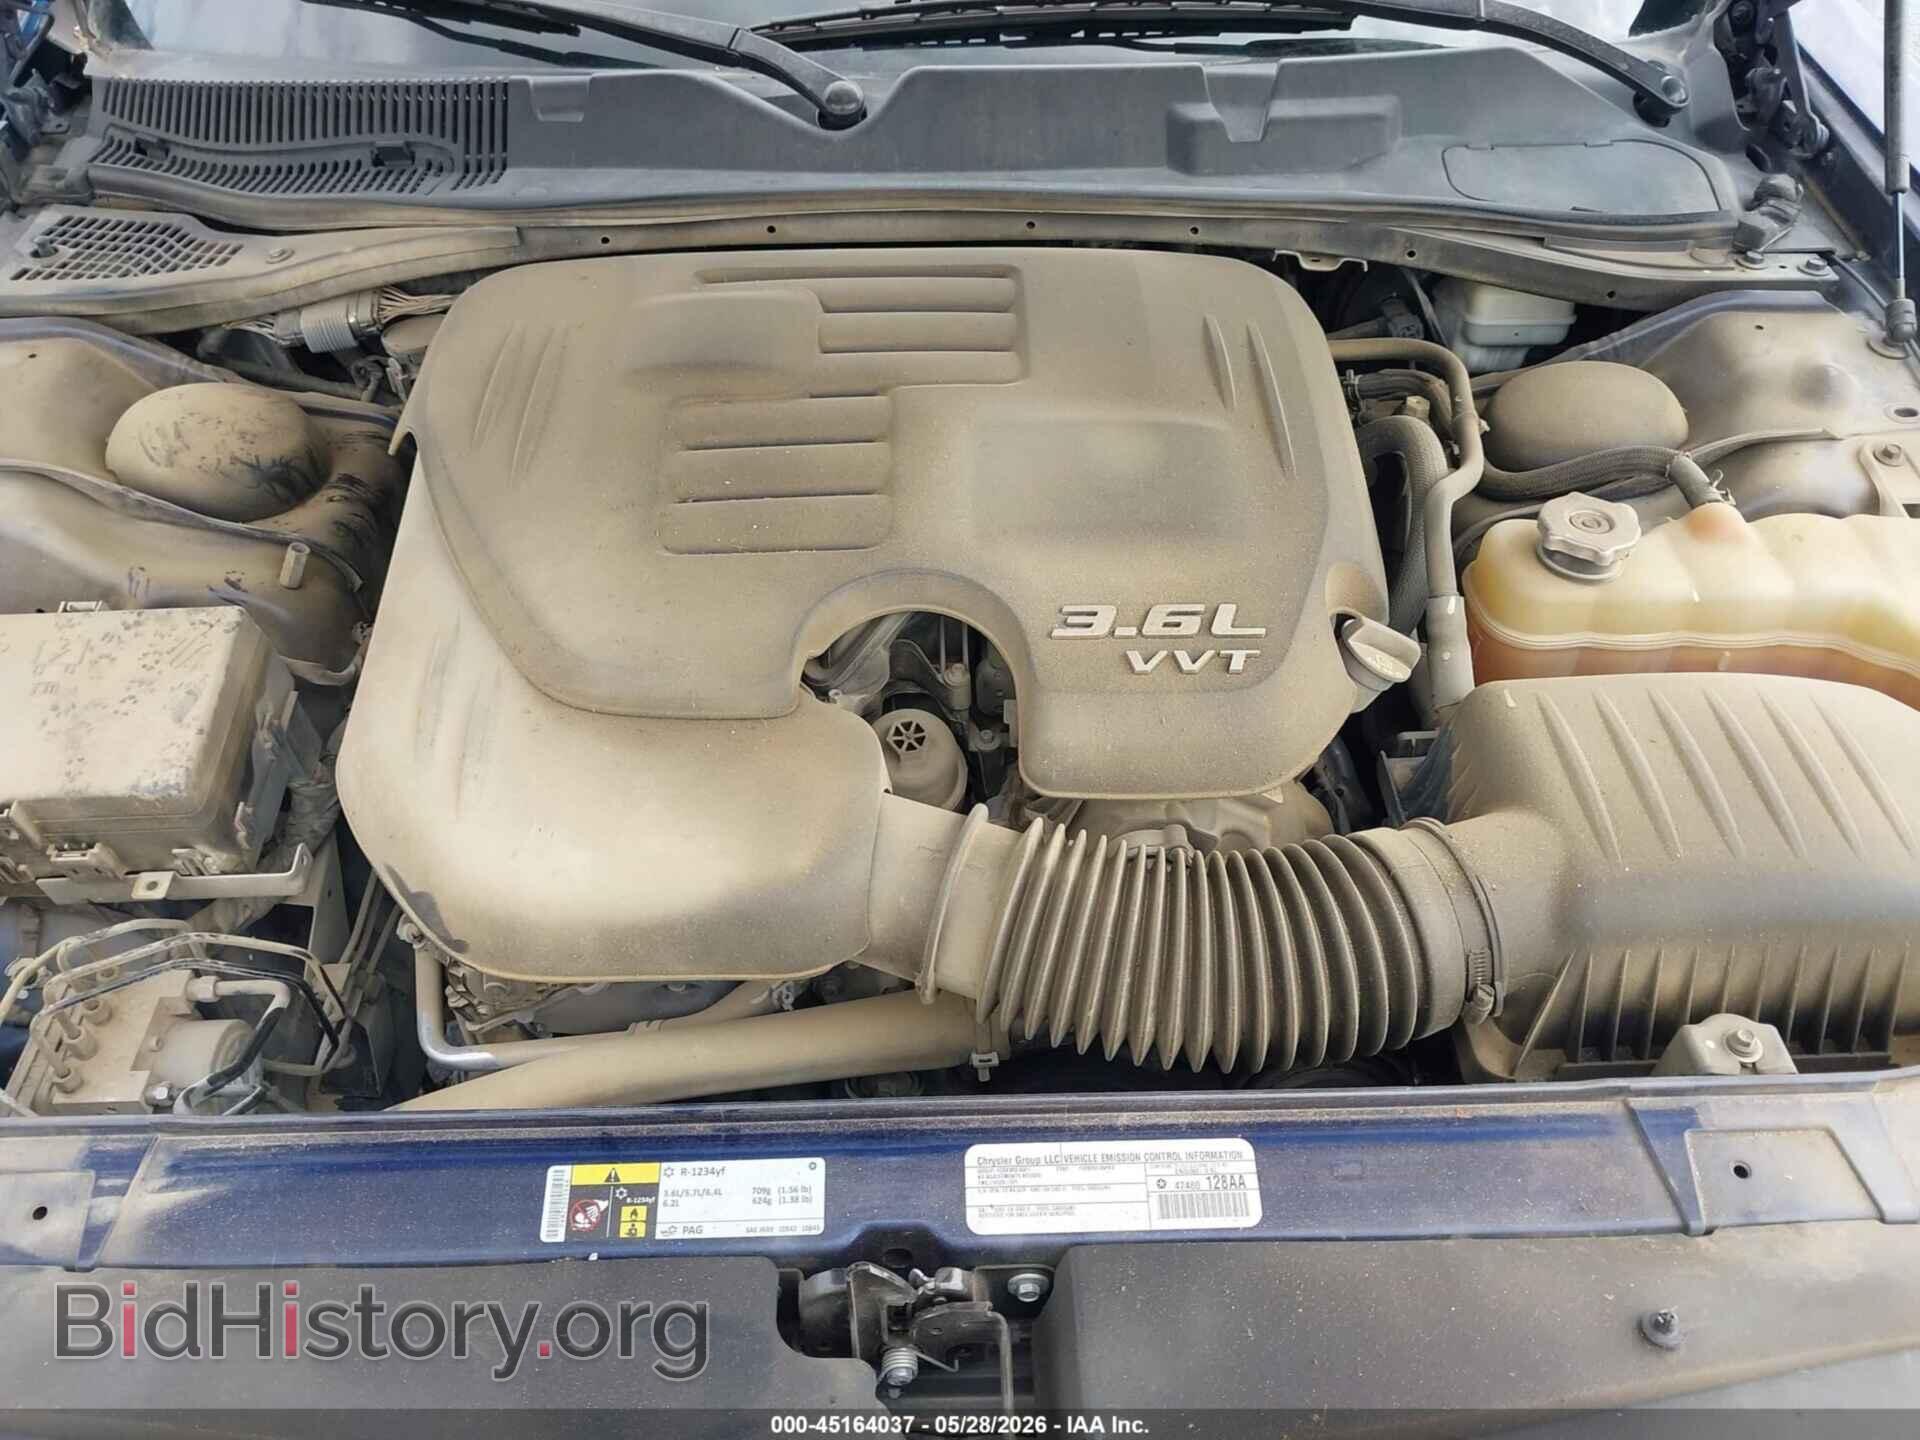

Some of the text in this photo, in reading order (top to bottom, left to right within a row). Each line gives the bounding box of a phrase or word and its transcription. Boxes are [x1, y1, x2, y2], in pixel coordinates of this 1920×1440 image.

[1049, 603, 1266, 639] 3.6L
[1125, 649, 1261, 674] VVT
[977, 1151, 1243, 1167] Chrysler Group LLC VEHICLE EMISSION CONTROL INFORMATION
[680, 1166, 727, 1179] R-1234yf
[1205, 1175, 1247, 1190] 128AA
[682, 1225, 704, 1235] PAG
